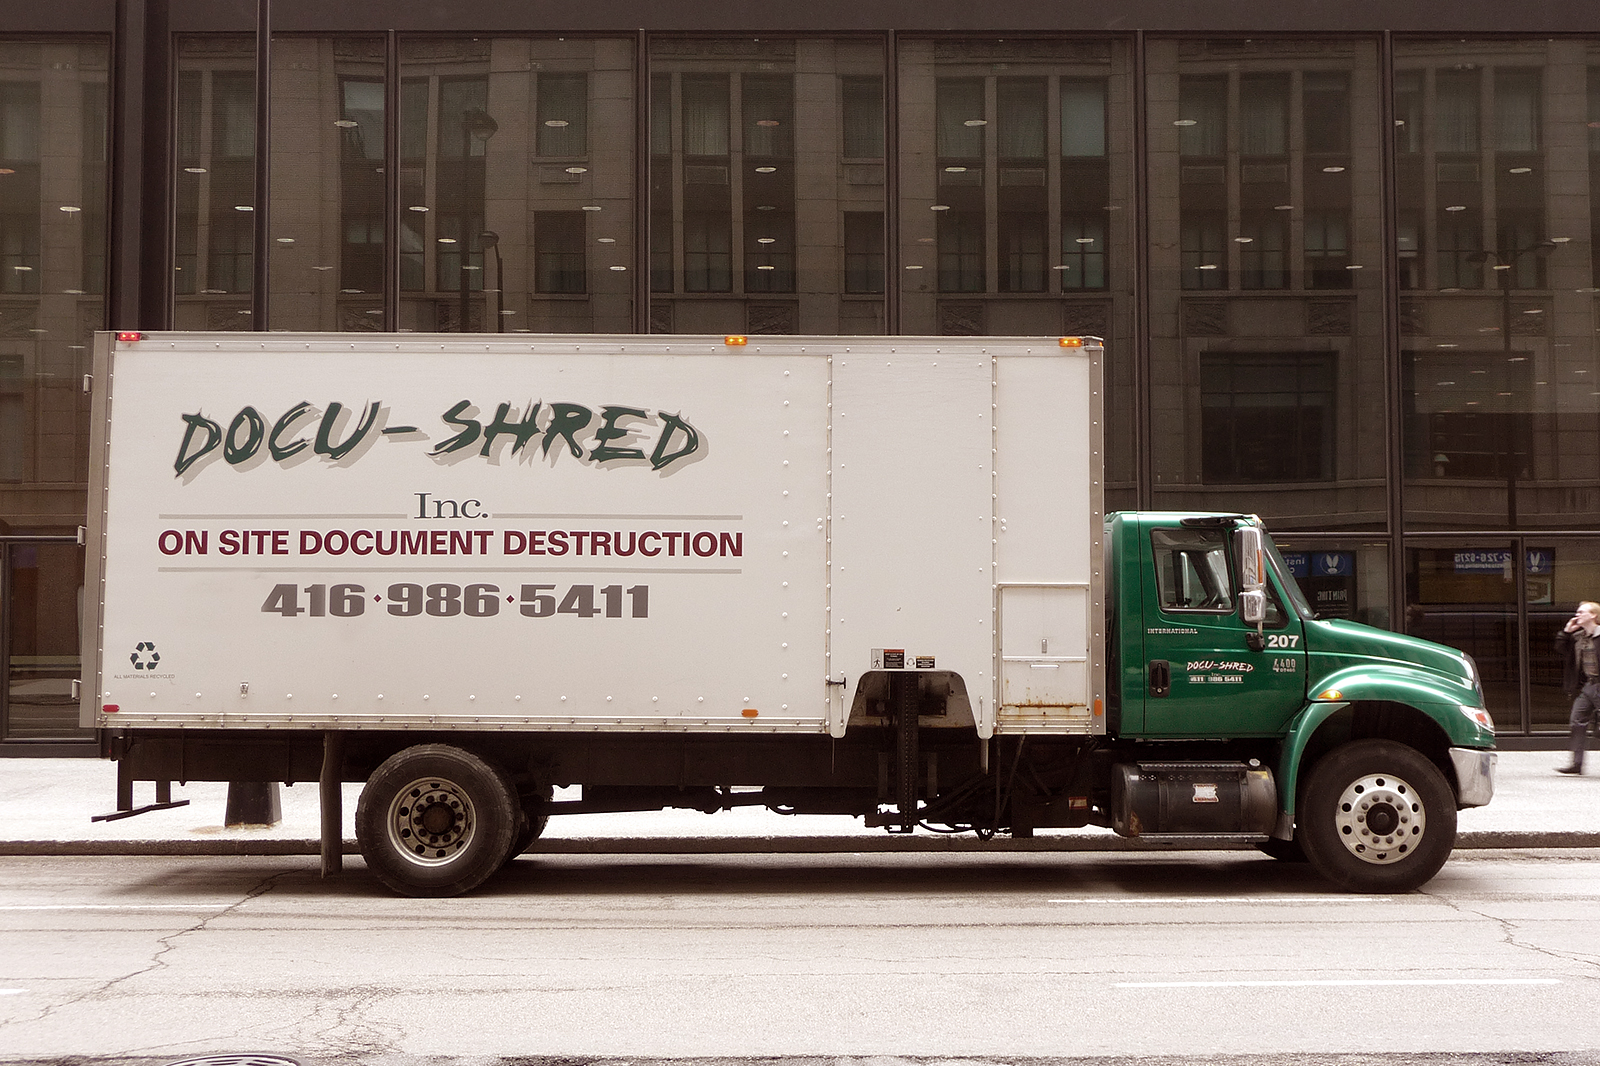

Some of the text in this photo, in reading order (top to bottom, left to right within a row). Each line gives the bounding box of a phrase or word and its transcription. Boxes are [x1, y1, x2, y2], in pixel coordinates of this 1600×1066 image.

[173, 398, 706, 482] DOCU-SHRED
[413, 492, 489, 520] Inc.
[158, 530, 743, 557] ON SITE DOCUMENT DESTRUCTION
[1267, 634, 1299, 648] 207
